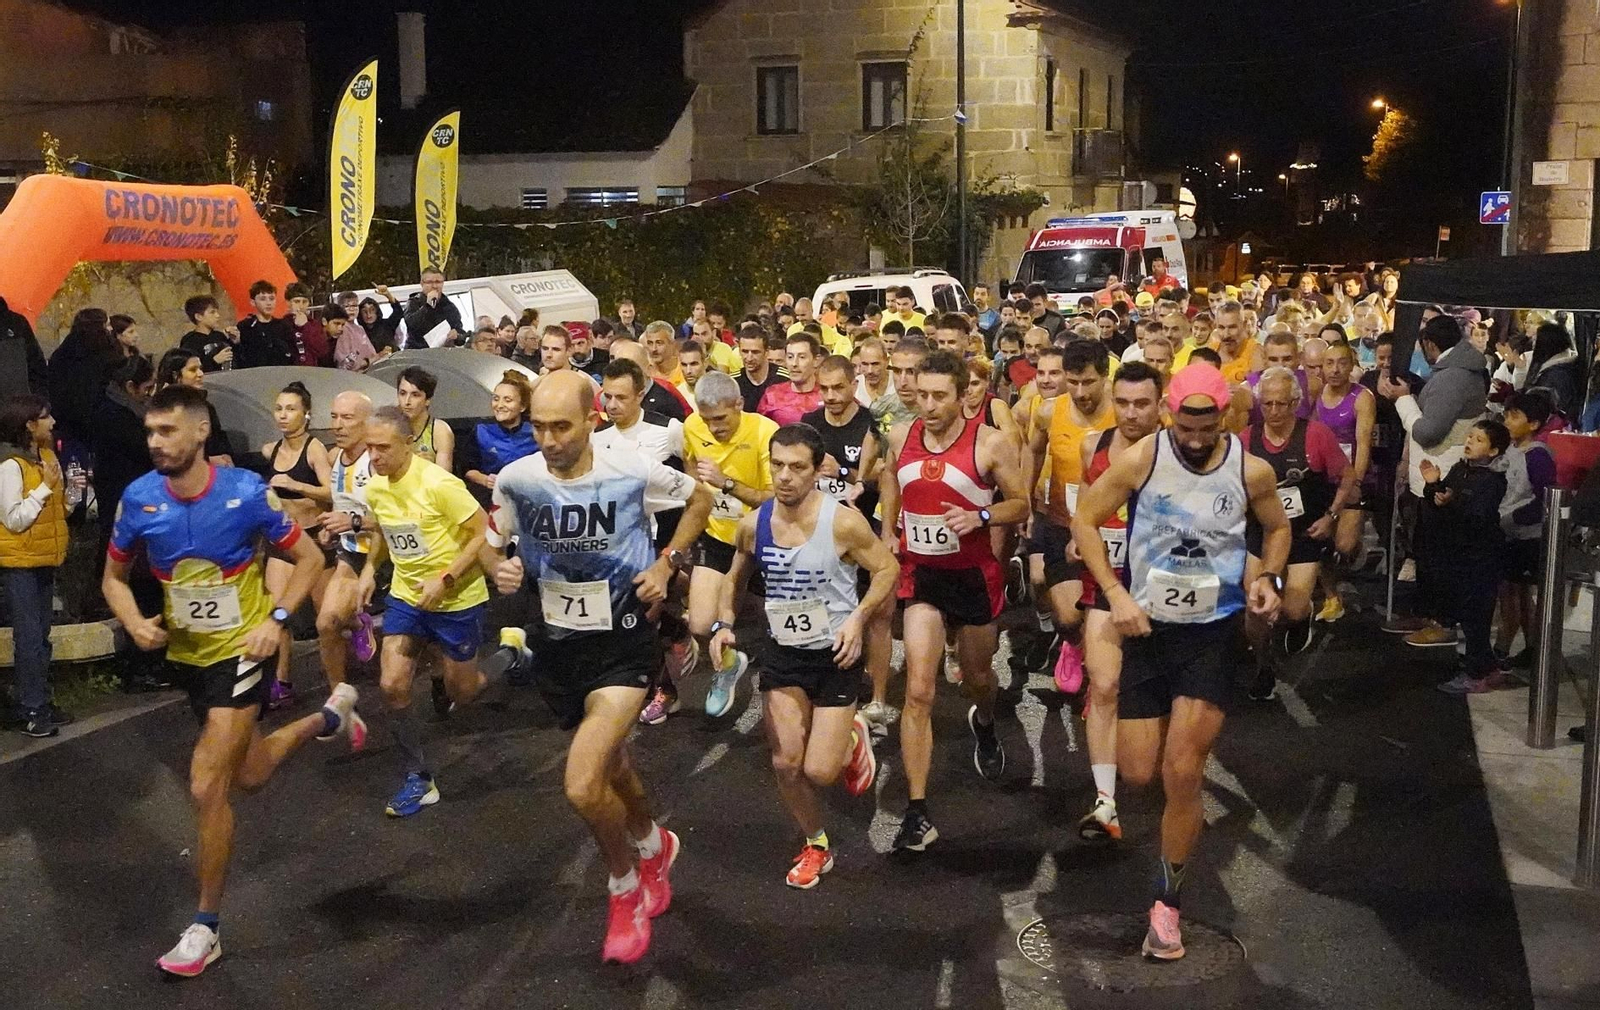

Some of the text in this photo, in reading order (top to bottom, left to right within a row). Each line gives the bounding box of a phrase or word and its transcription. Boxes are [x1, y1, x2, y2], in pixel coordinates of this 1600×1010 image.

[352, 79, 372, 89] CRN
[356, 88, 368, 96] TC
[433, 128, 453, 137] CRN
[437, 136, 449, 144] TC
[105, 189, 240, 229] CRONOTEC
[424, 198, 441, 268] RONO
[510, 278, 577, 295] CRONOTEC
[828, 480, 846, 494] 69
[532, 500, 617, 541] ADN
[389, 533, 419, 550] 108
[912, 525, 949, 545] 116
[541, 538, 609, 554] RUNNERS
[559, 594, 589, 617] 71
[1164, 587, 1198, 608] 24
[189, 600, 220, 619] 22
[783, 613, 812, 634] 43
